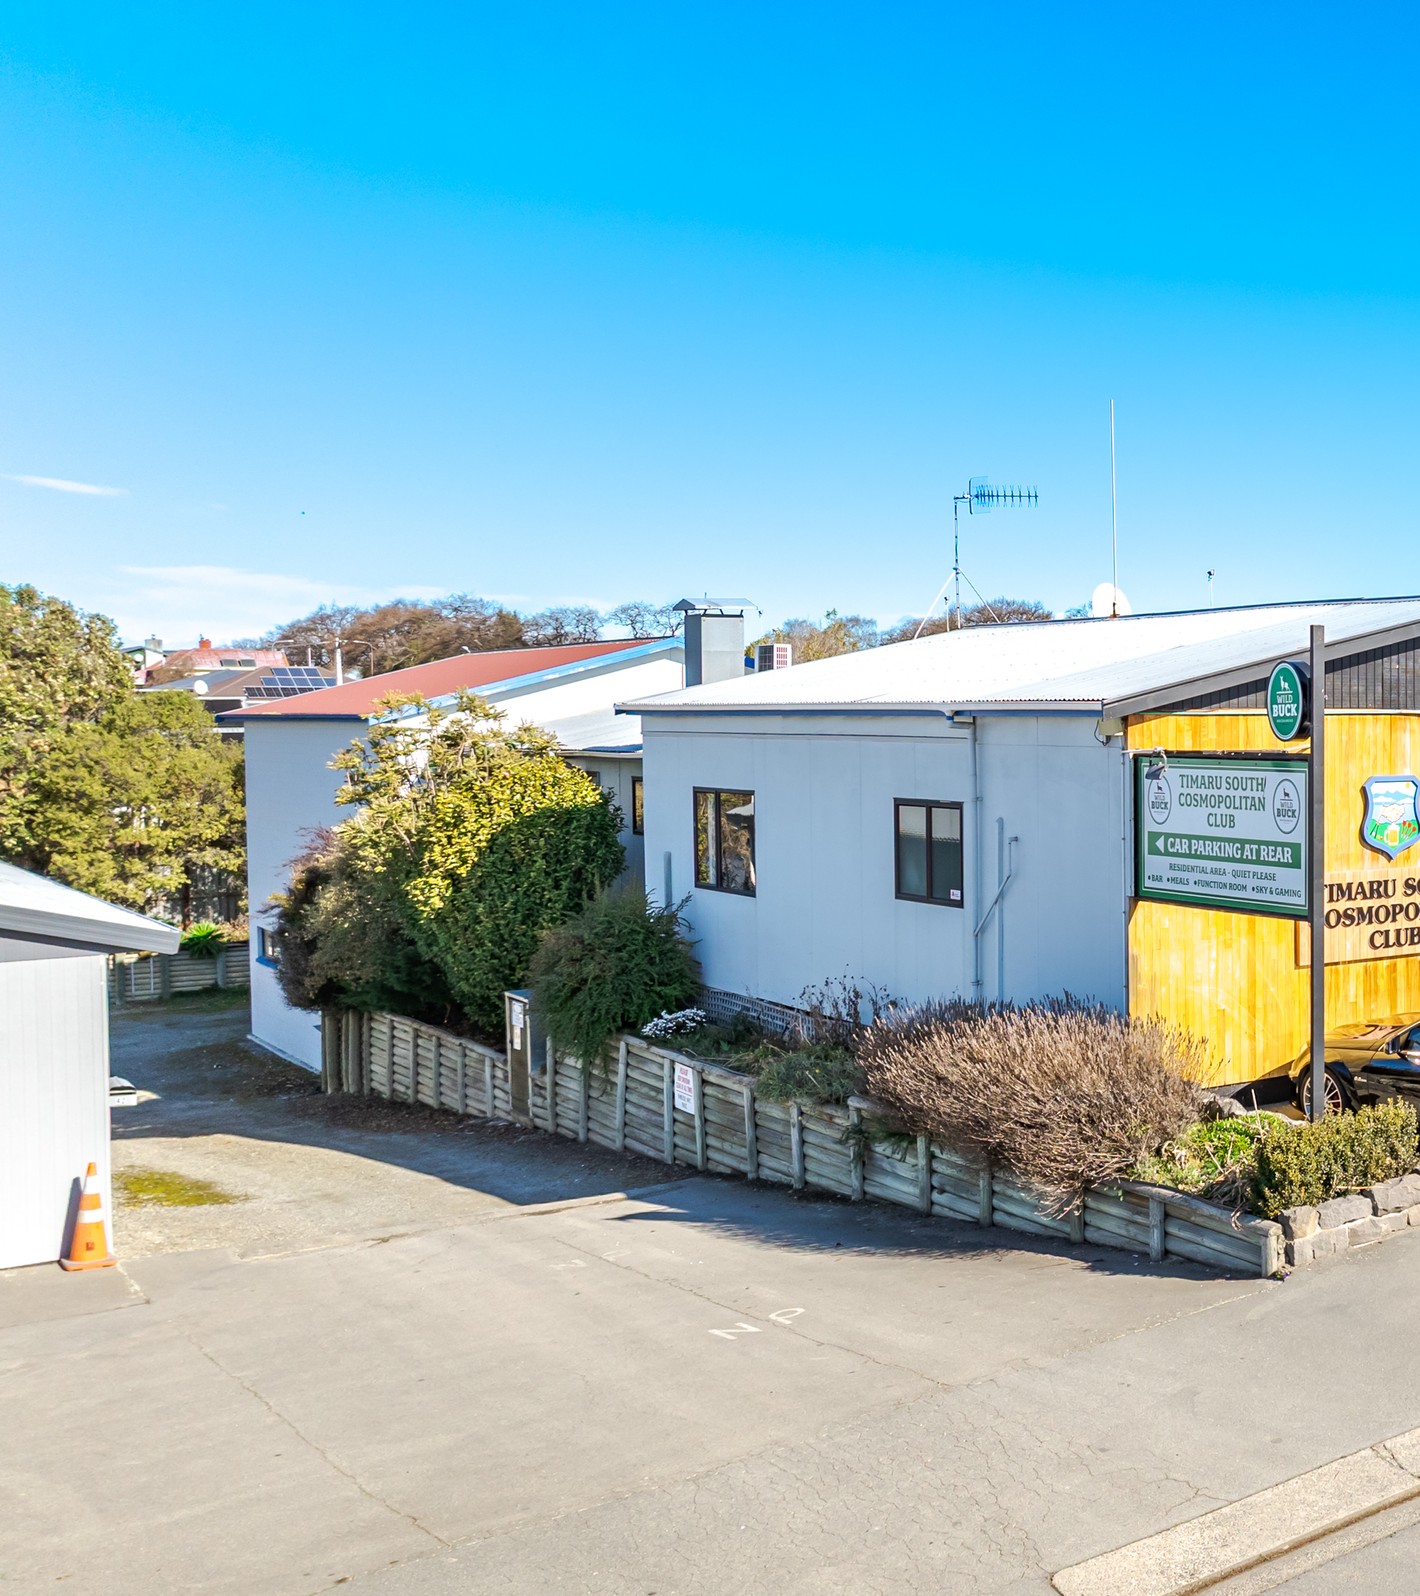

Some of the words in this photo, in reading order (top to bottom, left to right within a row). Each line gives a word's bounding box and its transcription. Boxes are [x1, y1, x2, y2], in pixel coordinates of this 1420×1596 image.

[1276, 694, 1293, 703] WILD
[1272, 704, 1297, 717] BUCK
[1179, 774, 1222, 790] TIMARU
[1225, 776, 1264, 792] SOUTH
[1151, 801, 1168, 810] BUCK
[1178, 793, 1266, 811] COSMOPOLITAN
[1207, 813, 1235, 829] CLUB
[1276, 808, 1297, 819] BUCK
[1167, 837, 1189, 853] CAR
[1191, 839, 1241, 859] PARKING
[1243, 844, 1258, 860] AT
[1260, 845, 1292, 863] REAR
[1168, 862, 1208, 875] RESIDENTIAL
[1209, 868, 1227, 876] AREA
[1231, 869, 1251, 879] QUIET
[1252, 871, 1277, 881] PLEASE
[1228, 883, 1247, 892] ROOM
[1274, 888, 1302, 898] GAMING
[1324, 878, 1397, 903] IMARU
